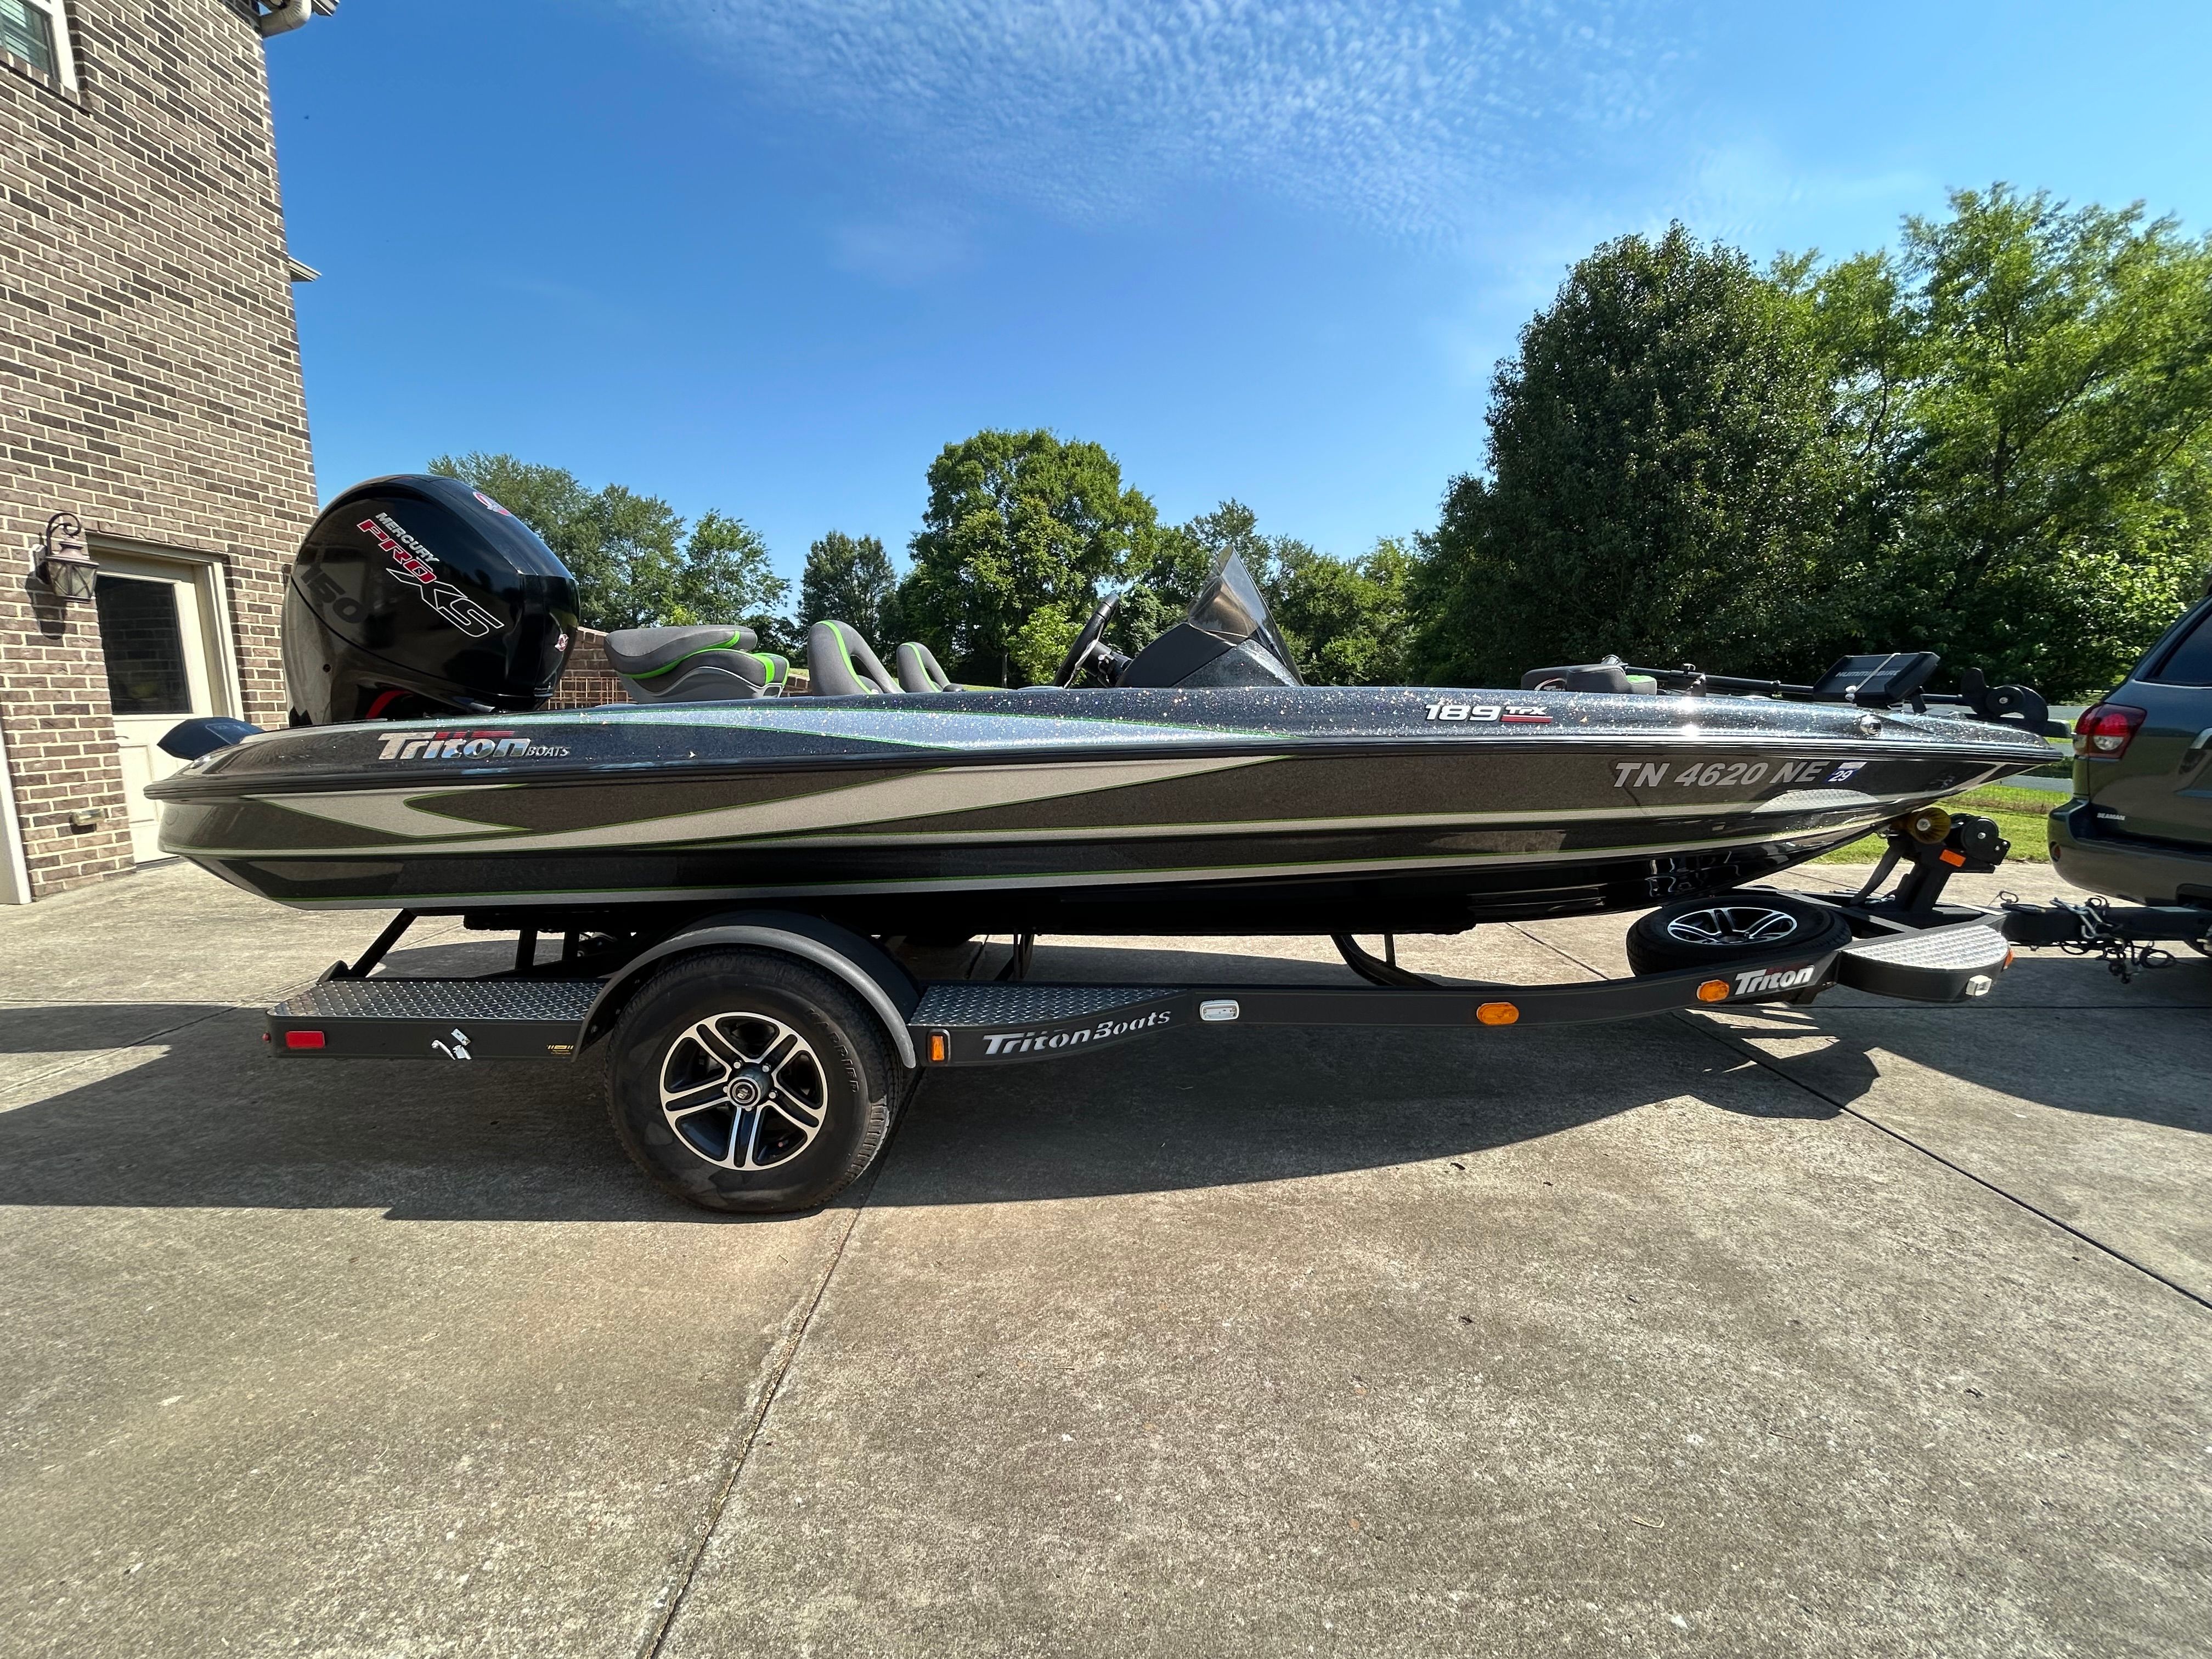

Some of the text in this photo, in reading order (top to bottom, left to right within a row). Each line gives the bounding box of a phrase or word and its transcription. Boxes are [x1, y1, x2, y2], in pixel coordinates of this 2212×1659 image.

[356, 518, 437, 584] PRO
[376, 512, 440, 562] MERCURY
[301, 562, 369, 624] 150
[386, 567, 505, 637] XS
[1425, 704, 1502, 721] 189
[377, 731, 572, 760] Triton BOATS
[1613, 761, 1831, 787] TN 4620 NE
[1827, 769, 1854, 782] 29
[1735, 964, 1815, 995] Triton
